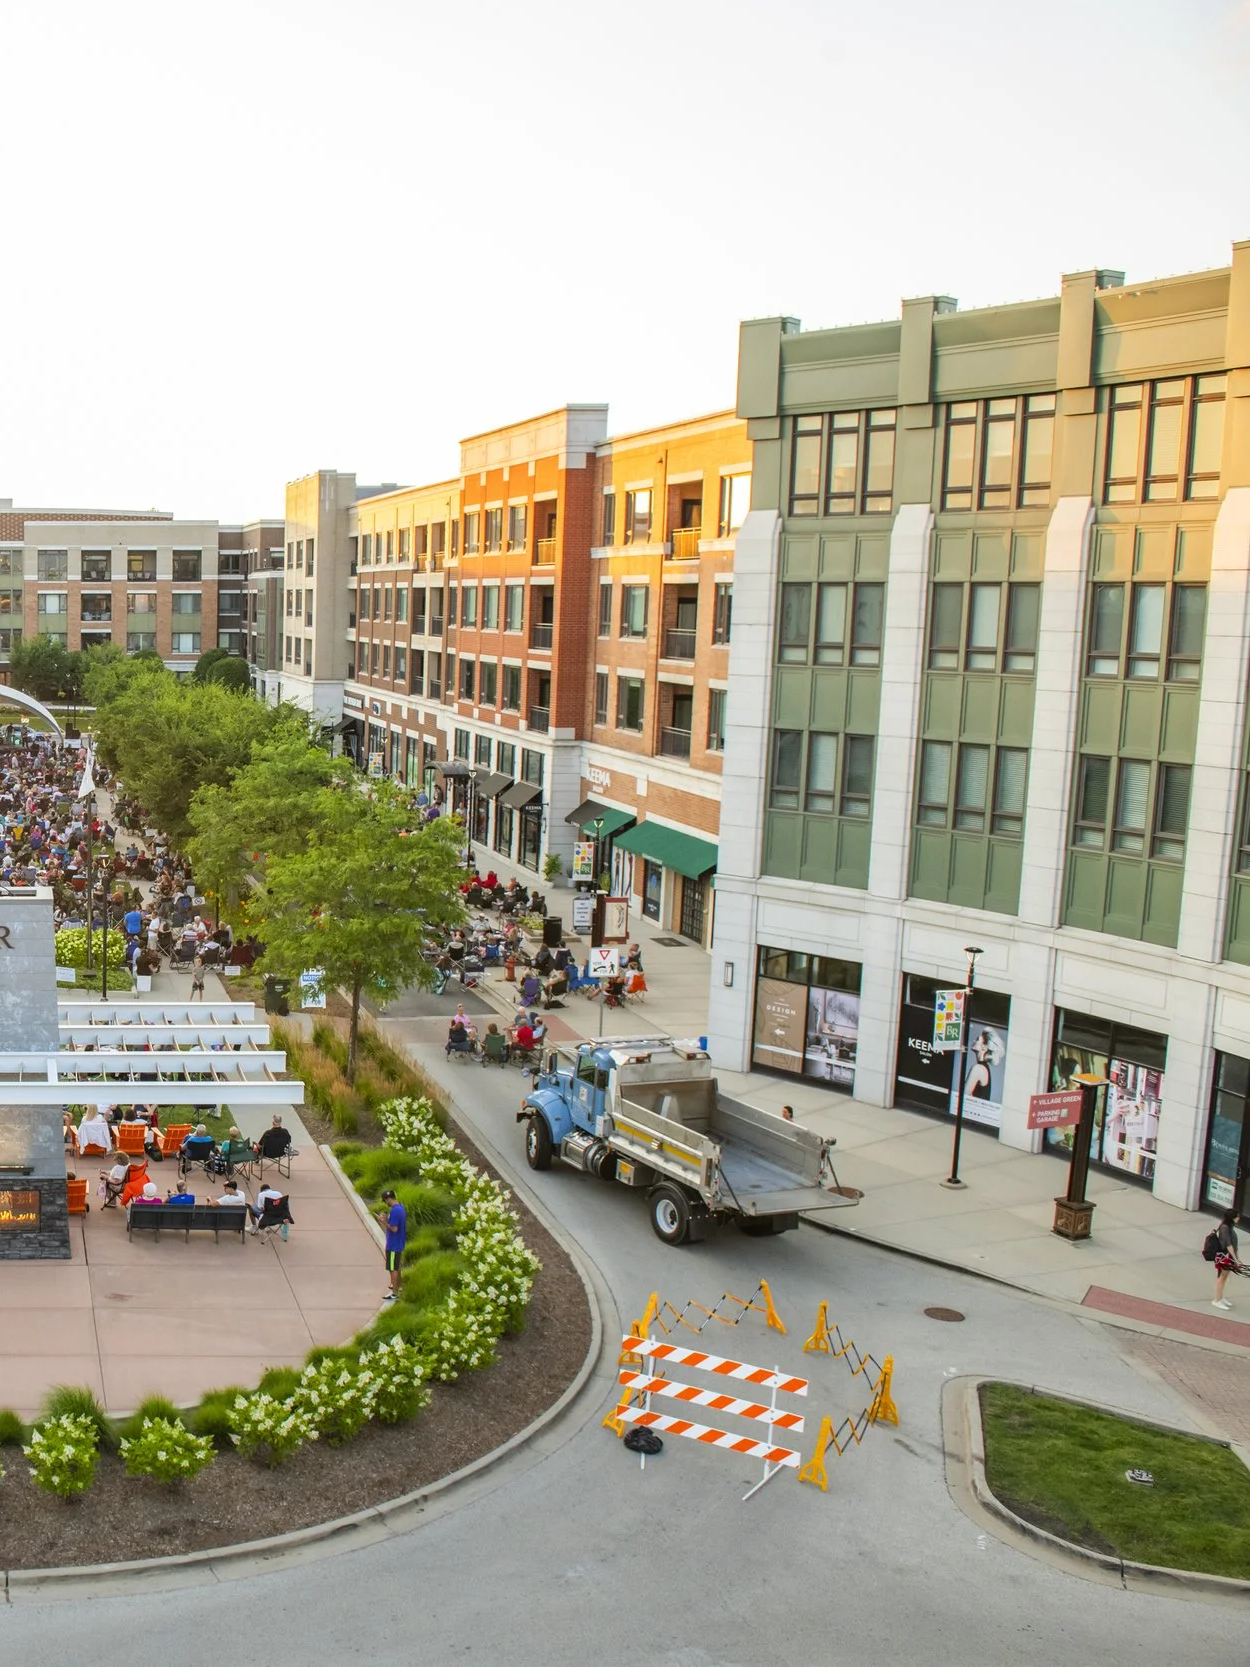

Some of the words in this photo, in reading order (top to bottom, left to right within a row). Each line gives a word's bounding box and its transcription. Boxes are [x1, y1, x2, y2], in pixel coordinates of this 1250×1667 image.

[587, 767, 611, 788] KEEMA
[766, 1004, 796, 1016] DESIGN
[946, 1025, 959, 1038] BR
[1038, 1096, 1061, 1105] VILLAGE
[1062, 1095, 1081, 1103] GREEN
[1037, 1109, 1060, 1117] PARKING
